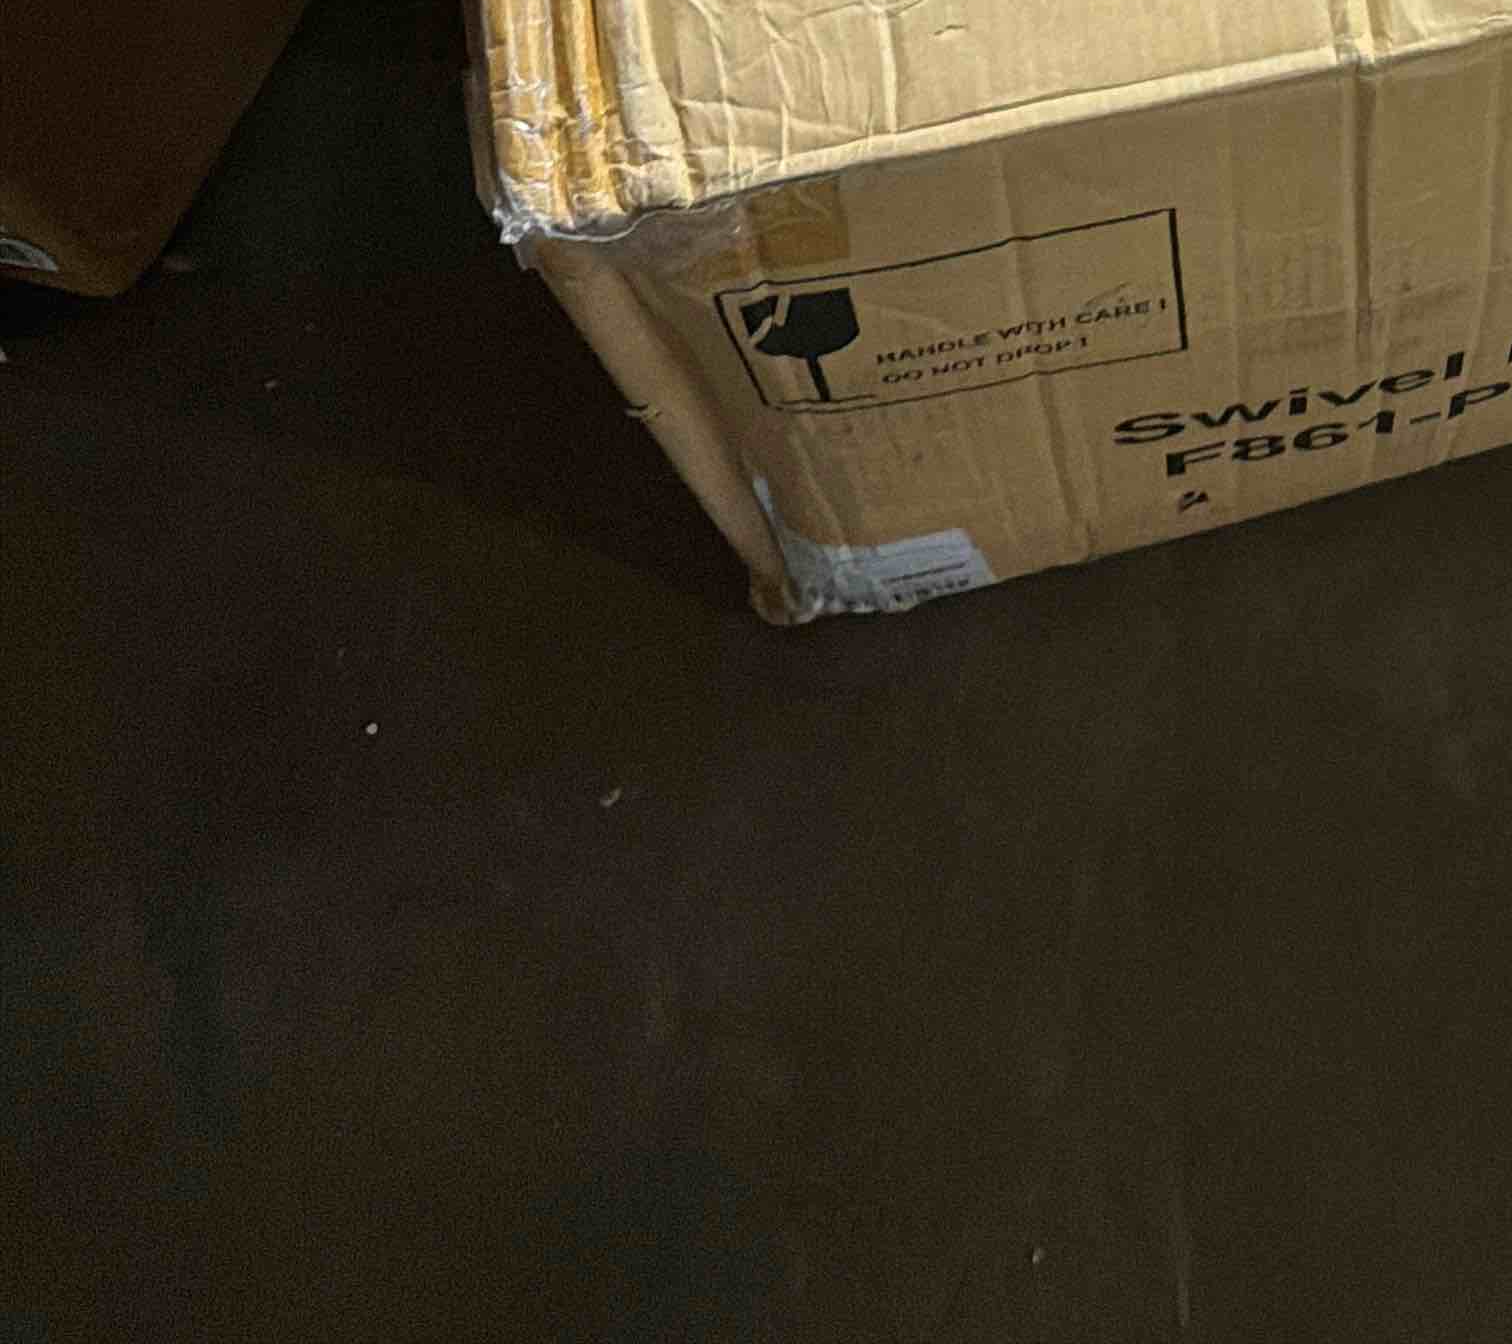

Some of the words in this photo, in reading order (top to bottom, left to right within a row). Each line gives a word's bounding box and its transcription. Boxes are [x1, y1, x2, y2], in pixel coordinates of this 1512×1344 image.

[876, 330, 990, 365] HANDLE
[999, 316, 1067, 341] WITH
[881, 370, 924, 385] DO
[931, 356, 985, 376] NOT
[1112, 349, 1465, 447] Swivel
